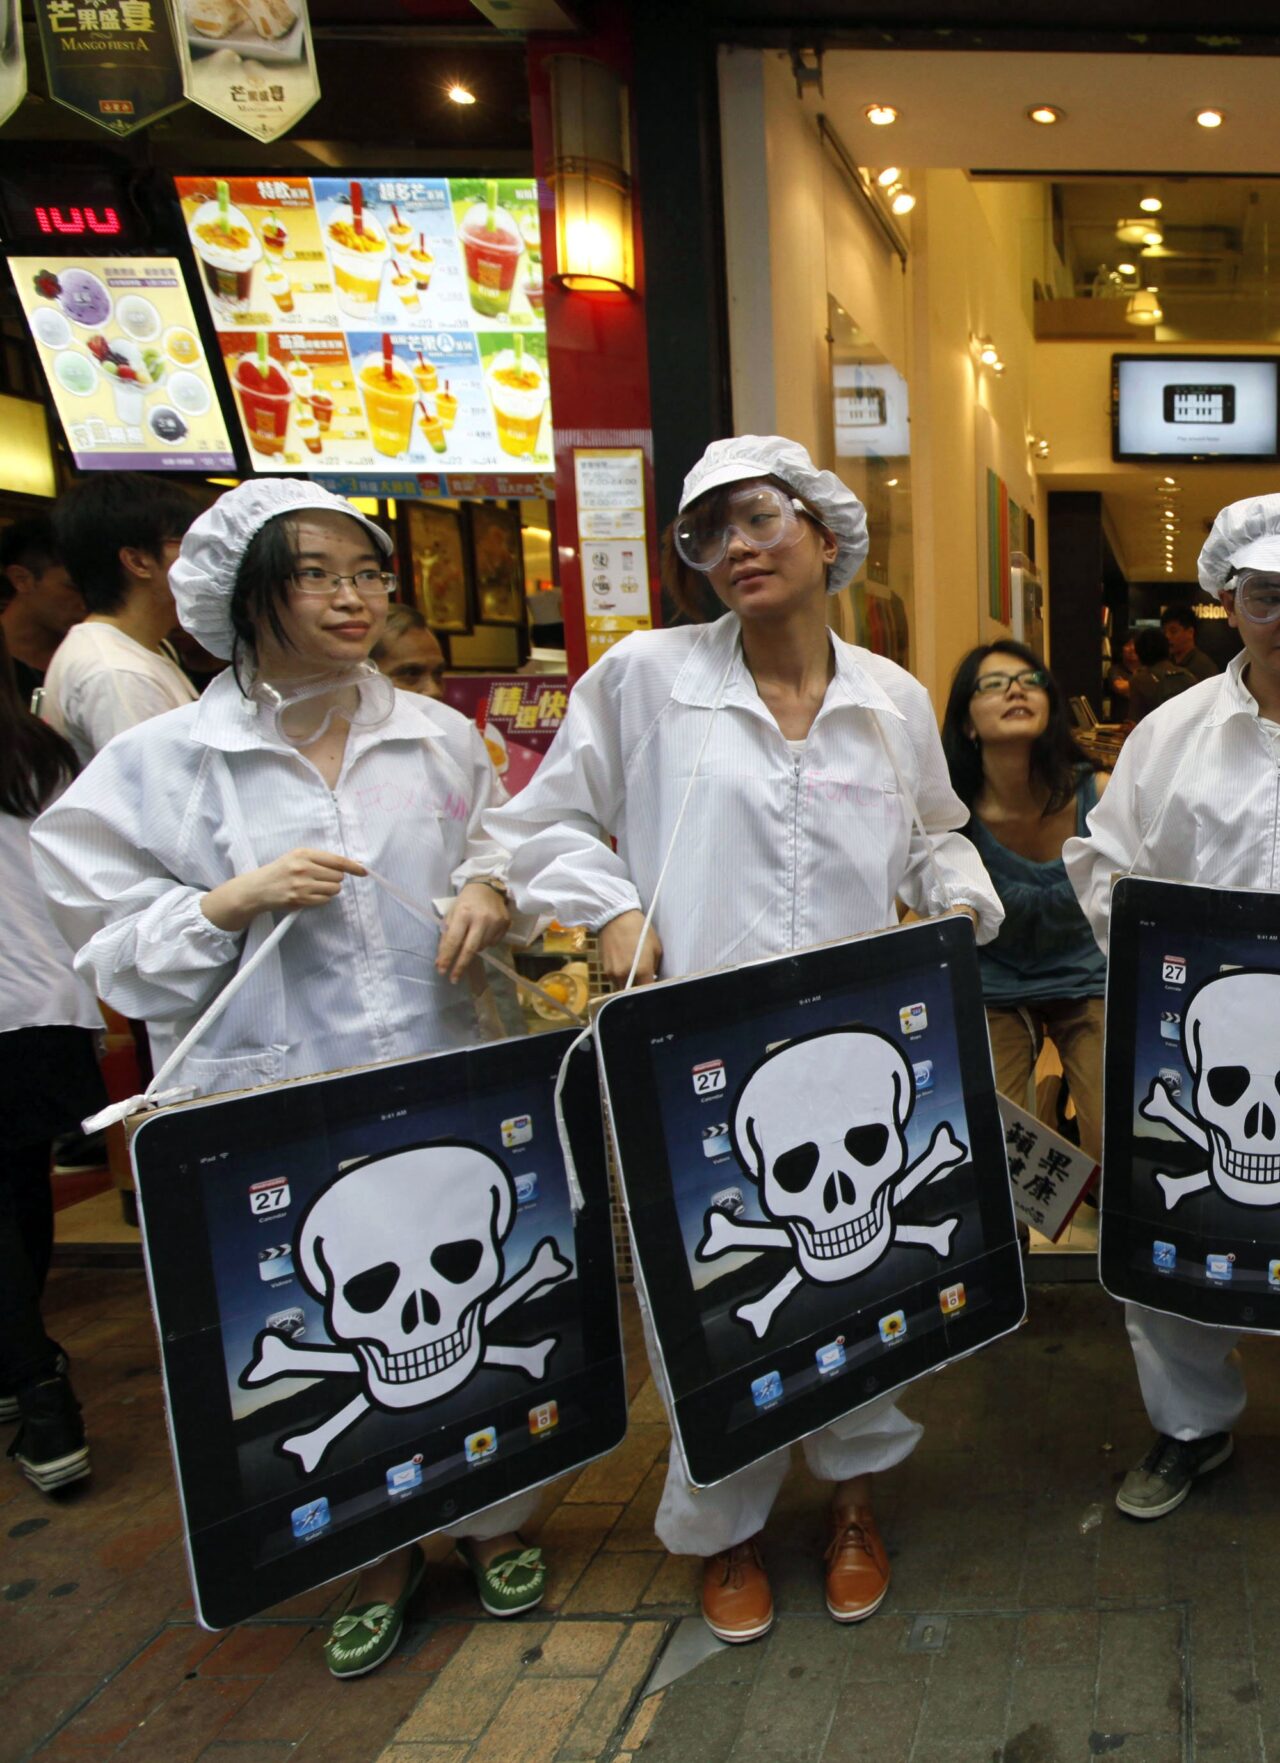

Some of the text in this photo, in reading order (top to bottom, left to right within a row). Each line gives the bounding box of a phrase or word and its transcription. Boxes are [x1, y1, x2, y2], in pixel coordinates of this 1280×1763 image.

[47, 0, 156, 33] 芒果盛宴
[61, 36, 106, 51] MANGO
[1164, 965, 1184, 981] 27
[697, 1070, 722, 1092] 27
[255, 1187, 286, 1211] 27
